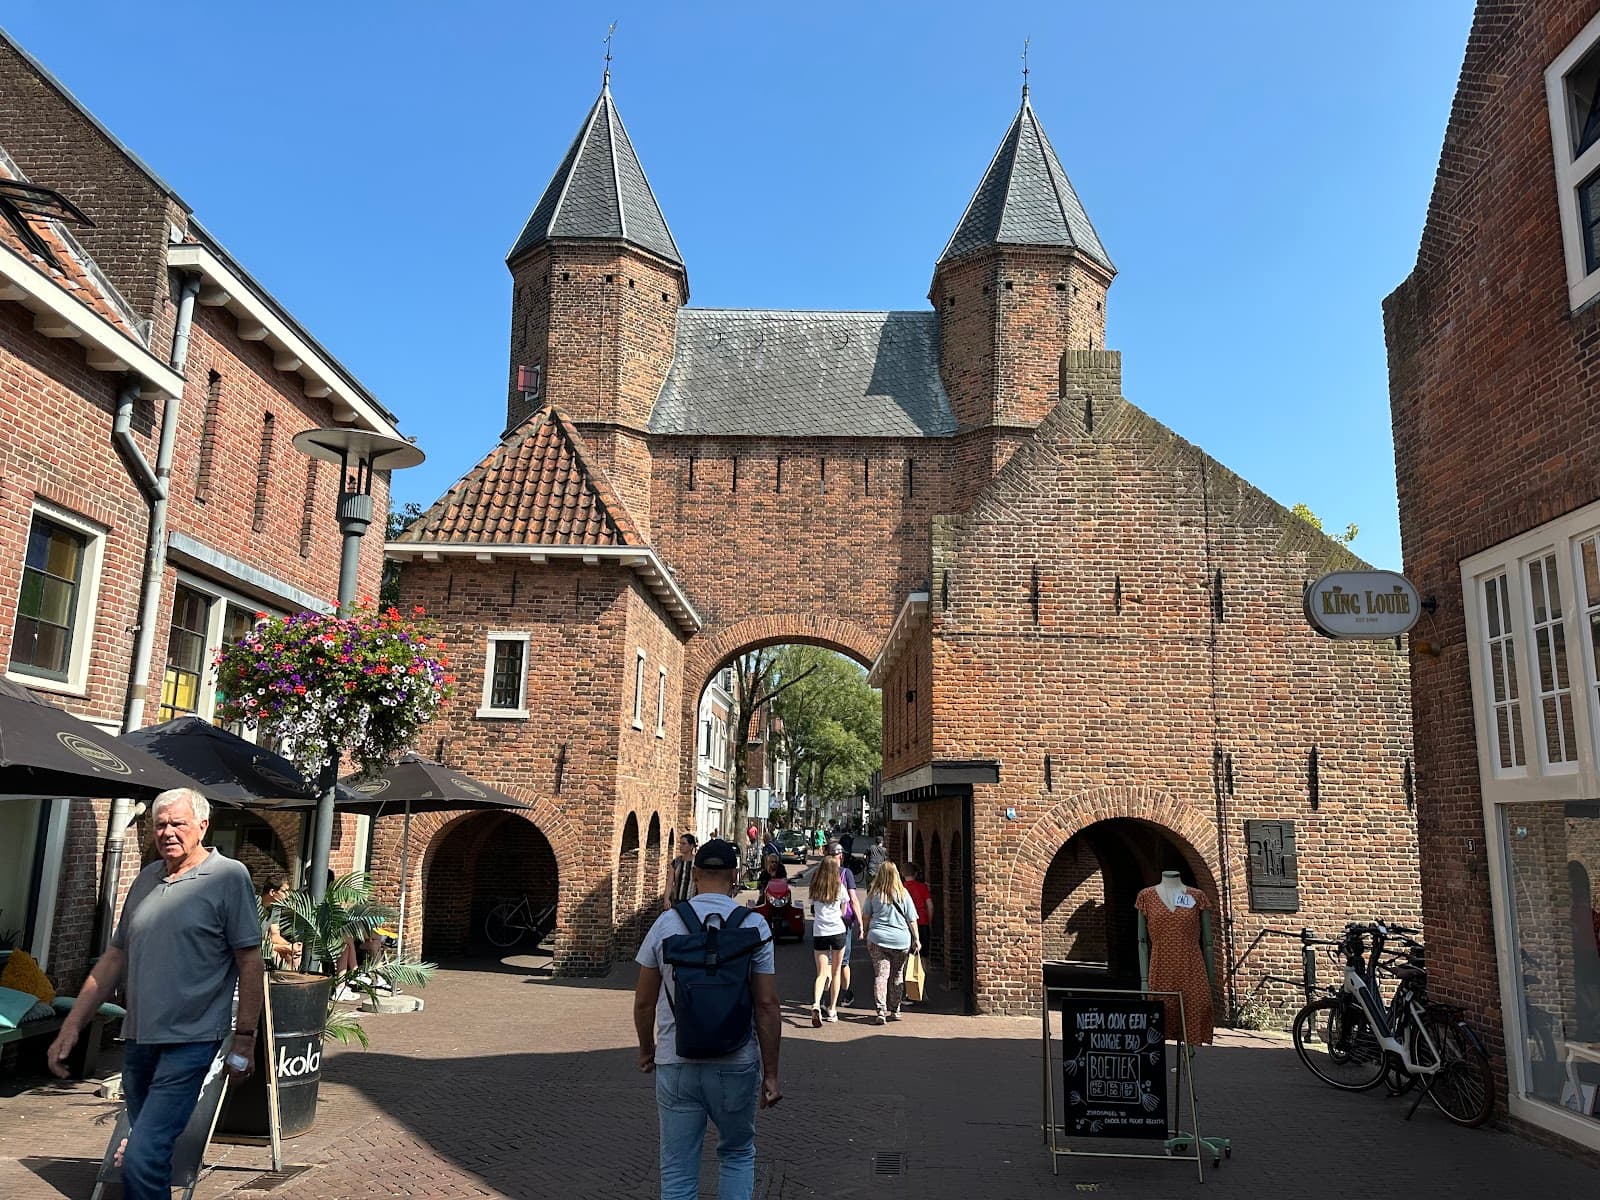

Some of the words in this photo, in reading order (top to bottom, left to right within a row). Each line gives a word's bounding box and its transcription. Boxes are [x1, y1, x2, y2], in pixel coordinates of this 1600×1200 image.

[1076, 1012, 1105, 1029] NEEM
[1107, 1013, 1127, 1029] OOK
[1129, 1013, 1147, 1029] EEN
[1090, 1033, 1122, 1049] KIJKJE
[1125, 1034, 1141, 1050] BIJ
[1090, 1055, 1137, 1079] BOETIEK
